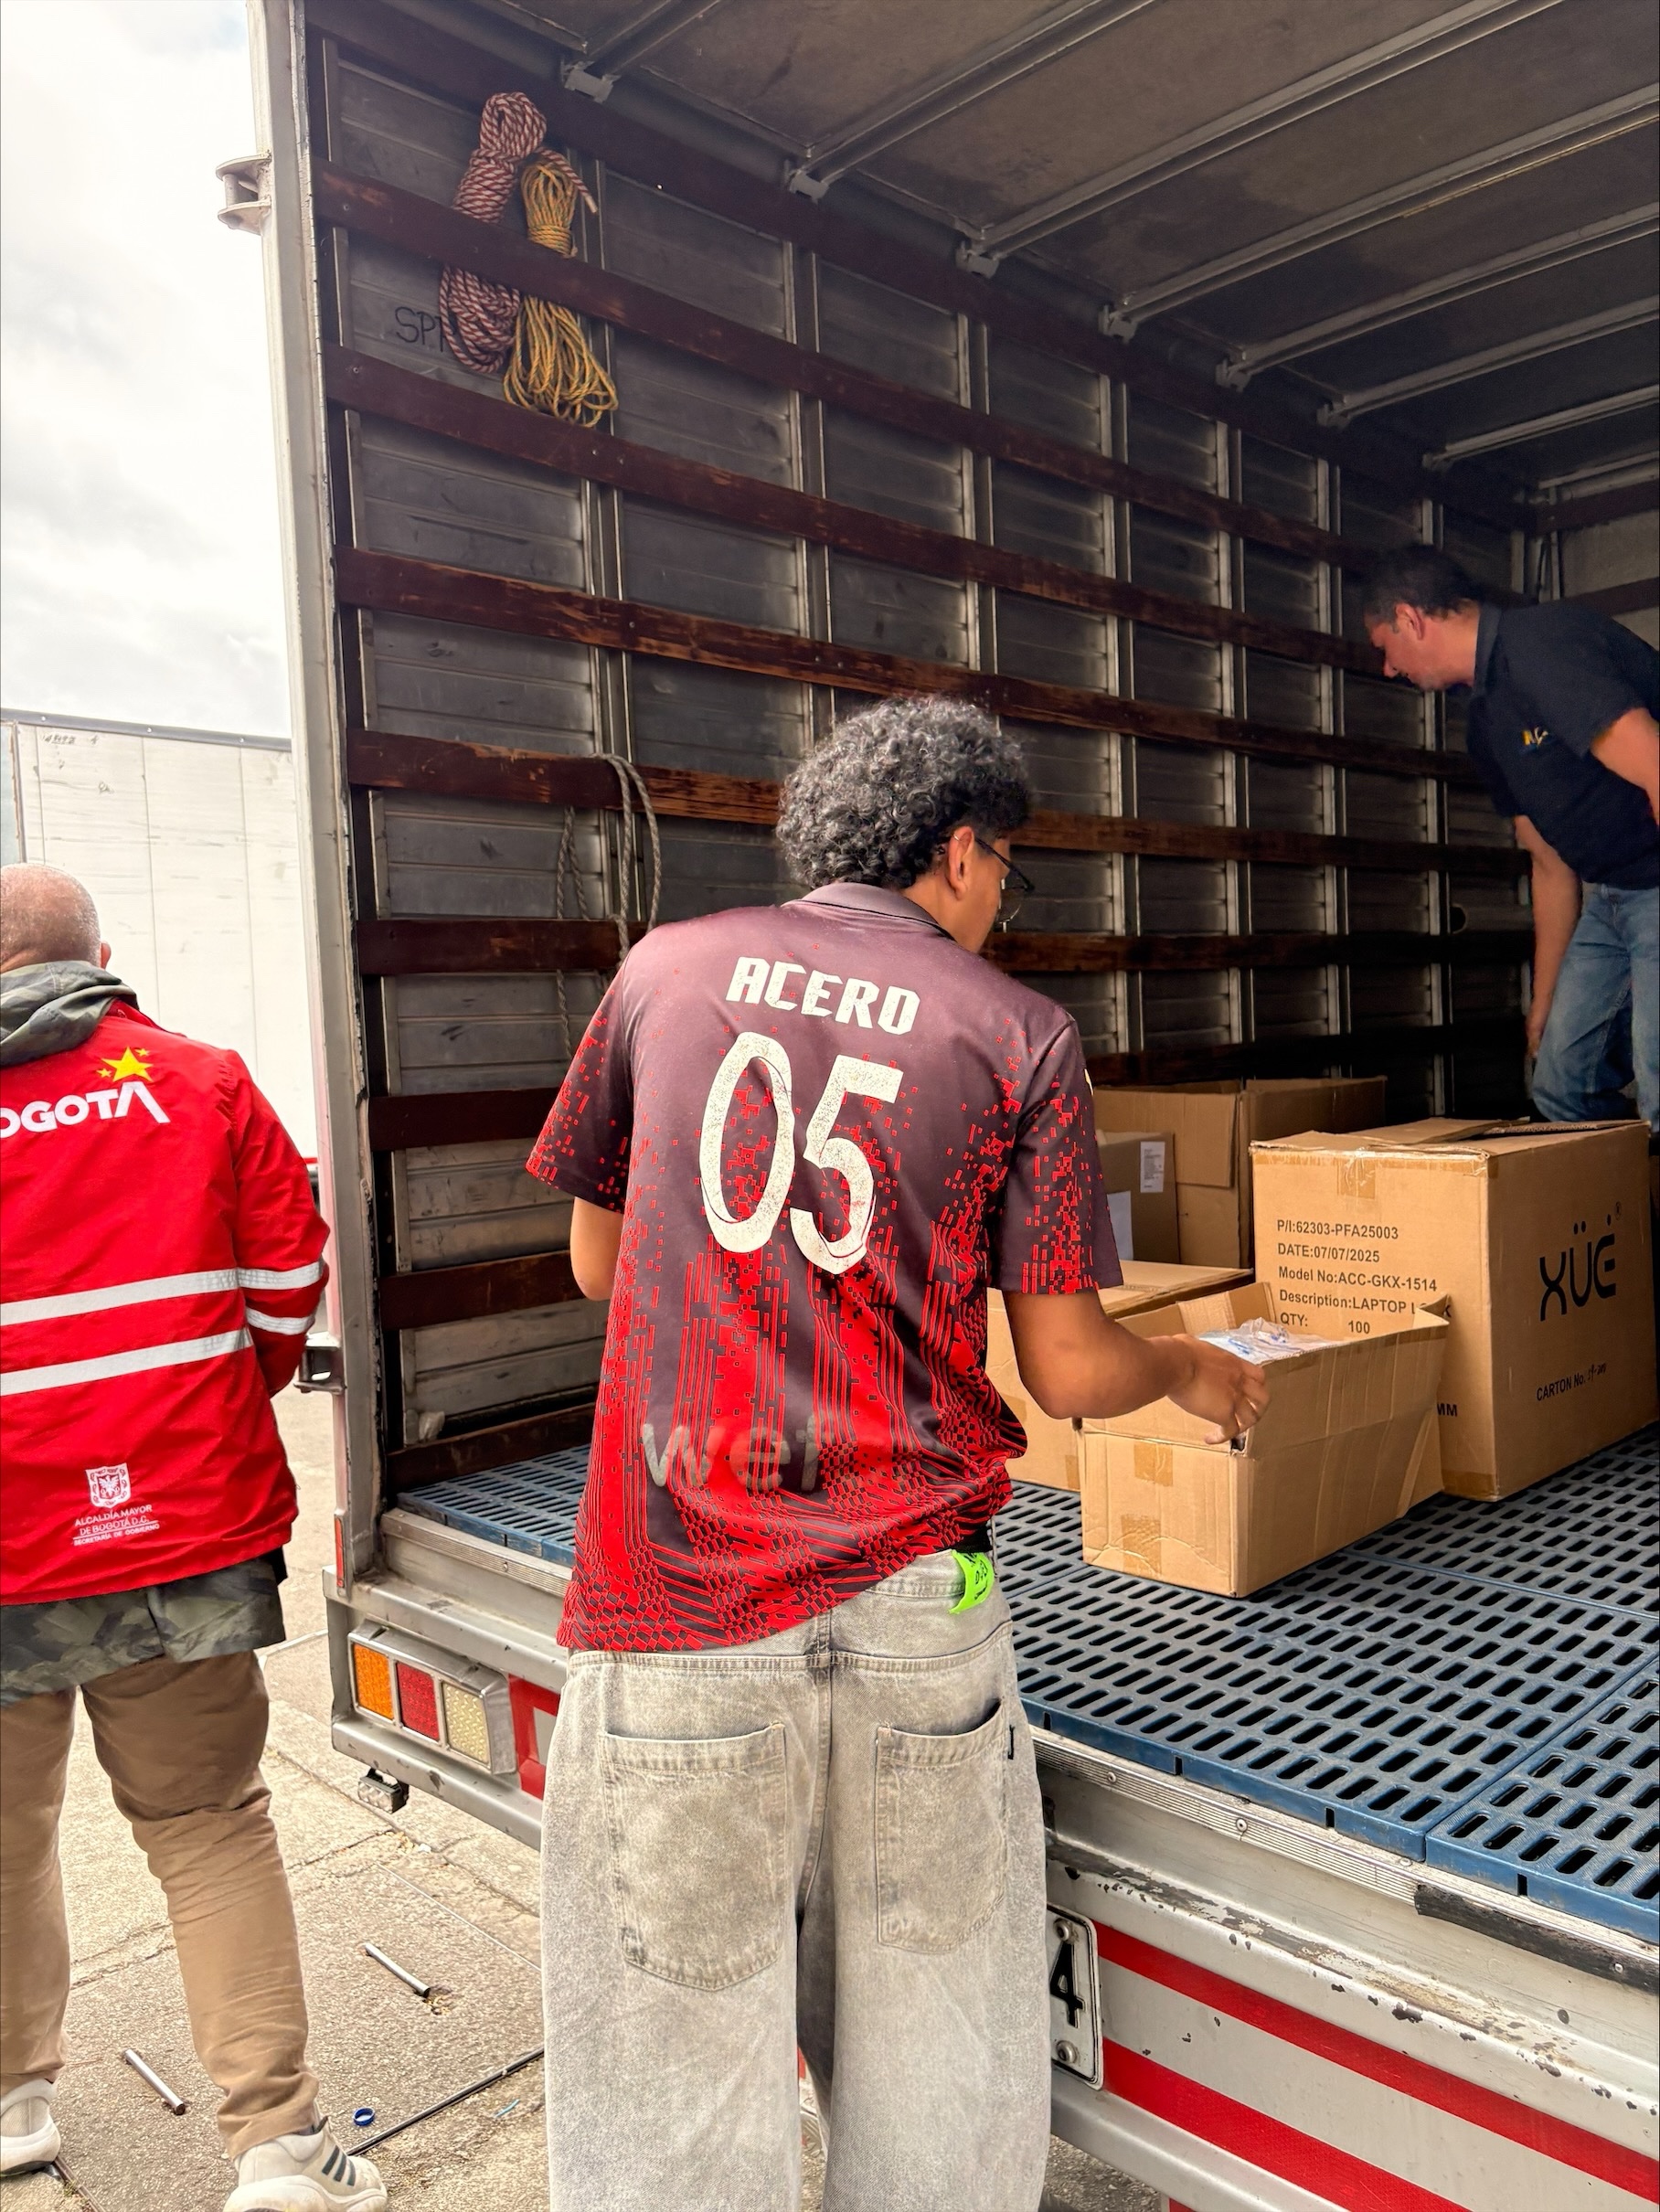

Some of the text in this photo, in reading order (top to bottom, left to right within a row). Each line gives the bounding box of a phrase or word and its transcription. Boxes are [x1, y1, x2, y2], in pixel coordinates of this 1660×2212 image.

[726, 956, 920, 1036] ACERO
[699, 1031, 904, 1275] 05
[1277, 1219, 1399, 1239] P/I:62303-PFA25003
[1278, 1242, 1380, 1262] DATE:07/07/2025
[1279, 1266, 1438, 1292] Model No:ACC-GKX-1514
[1280, 1289, 1407, 1313] Description:LAPTOP
[1280, 1311, 1370, 1335] QTY: 100
[1537, 1376, 1572, 1401] CARTON
[1574, 1372, 1586, 1388] No.
[75, 1505, 153, 1526] ALCALDÍA MAYOR
[80, 1526, 91, 1536] DE
[92, 1517, 131, 1533] BOGOTÁ
[1048, 1940, 1086, 2029] 4
